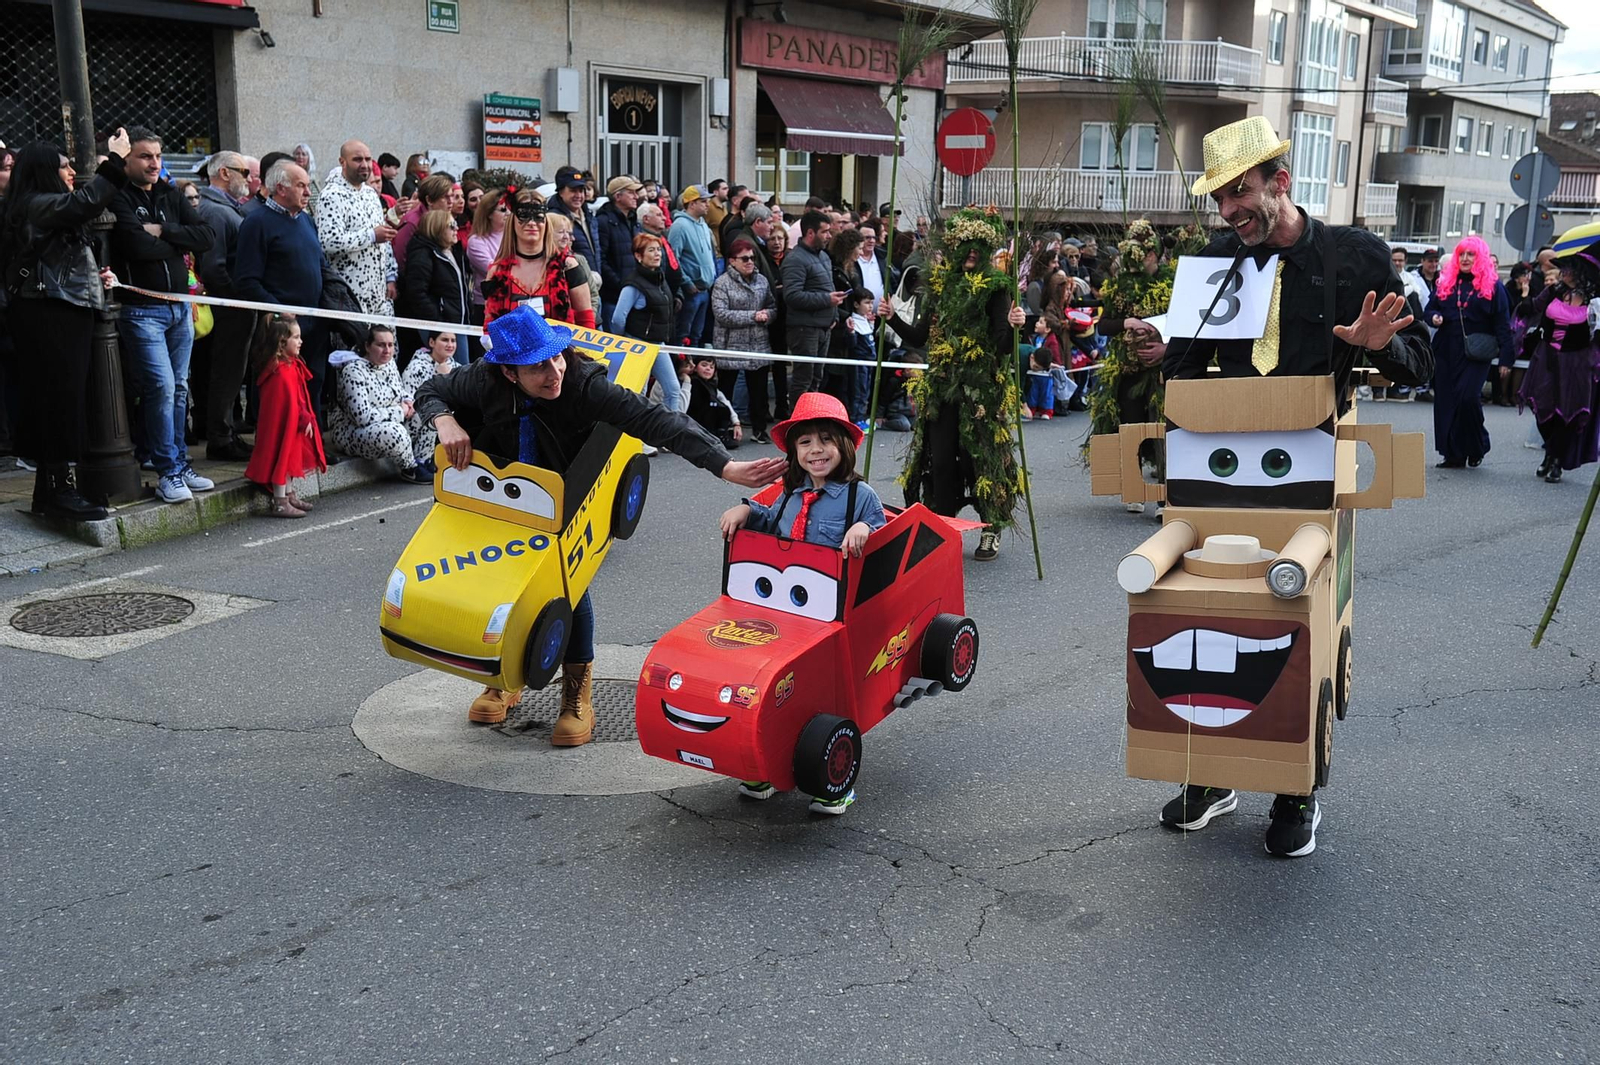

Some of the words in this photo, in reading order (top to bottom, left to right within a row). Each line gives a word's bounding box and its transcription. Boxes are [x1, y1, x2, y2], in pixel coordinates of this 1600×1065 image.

[431, 17, 439, 26] DO
[440, 18, 456, 28] AREAL
[441, 7, 453, 16] RUA
[766, 32, 926, 78] PANADERA
[505, 108, 531, 118] MUNICIPAL
[630, 110, 637, 126] 1
[486, 148, 499, 157] Local
[511, 136, 531, 145] infantil
[1199, 269, 1243, 326] 3
[572, 328, 647, 354] INOCO
[567, 459, 612, 541] DINOCO
[415, 534, 550, 582] DINOCO
[567, 520, 593, 579] 51
[886, 628, 909, 665] 95
[734, 686, 757, 705] 95
[775, 671, 795, 707] 95
